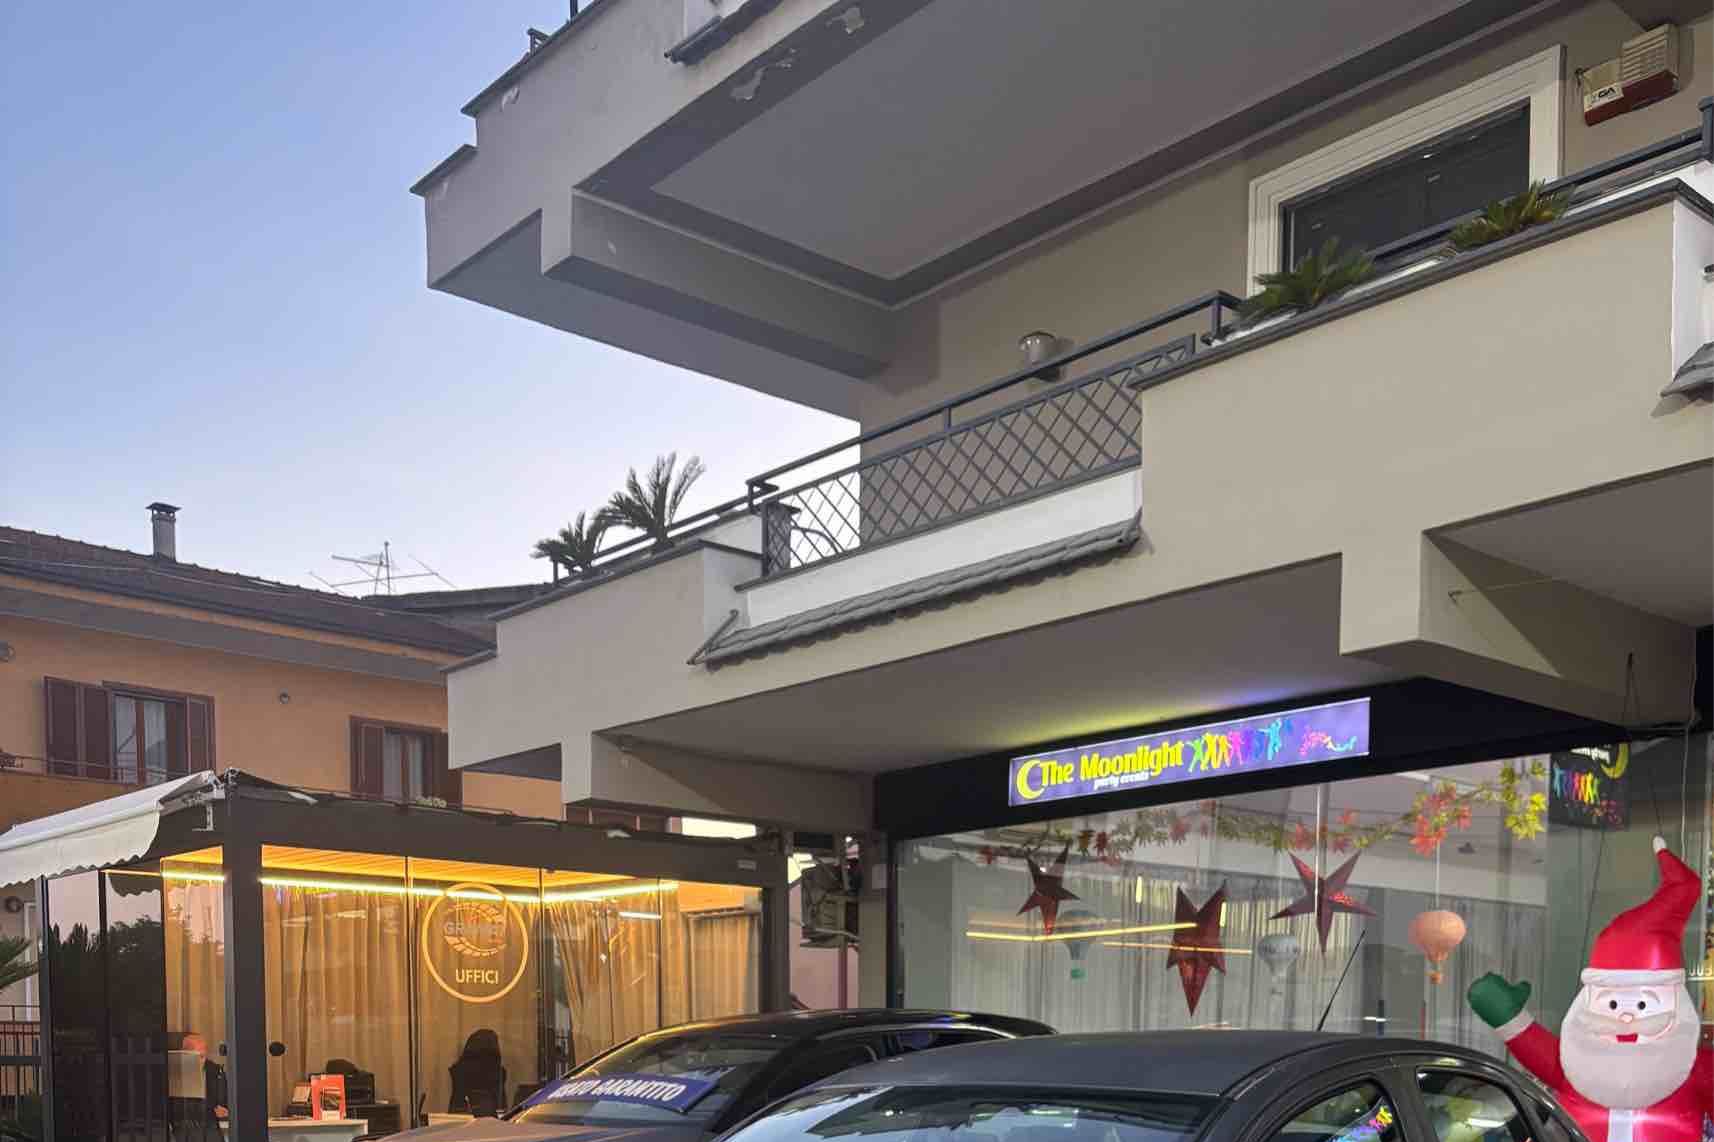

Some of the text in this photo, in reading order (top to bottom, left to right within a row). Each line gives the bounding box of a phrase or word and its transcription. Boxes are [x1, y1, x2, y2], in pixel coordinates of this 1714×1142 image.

[1042, 741, 1184, 787] The Moonlight
[455, 969, 499, 985] UFFICI
